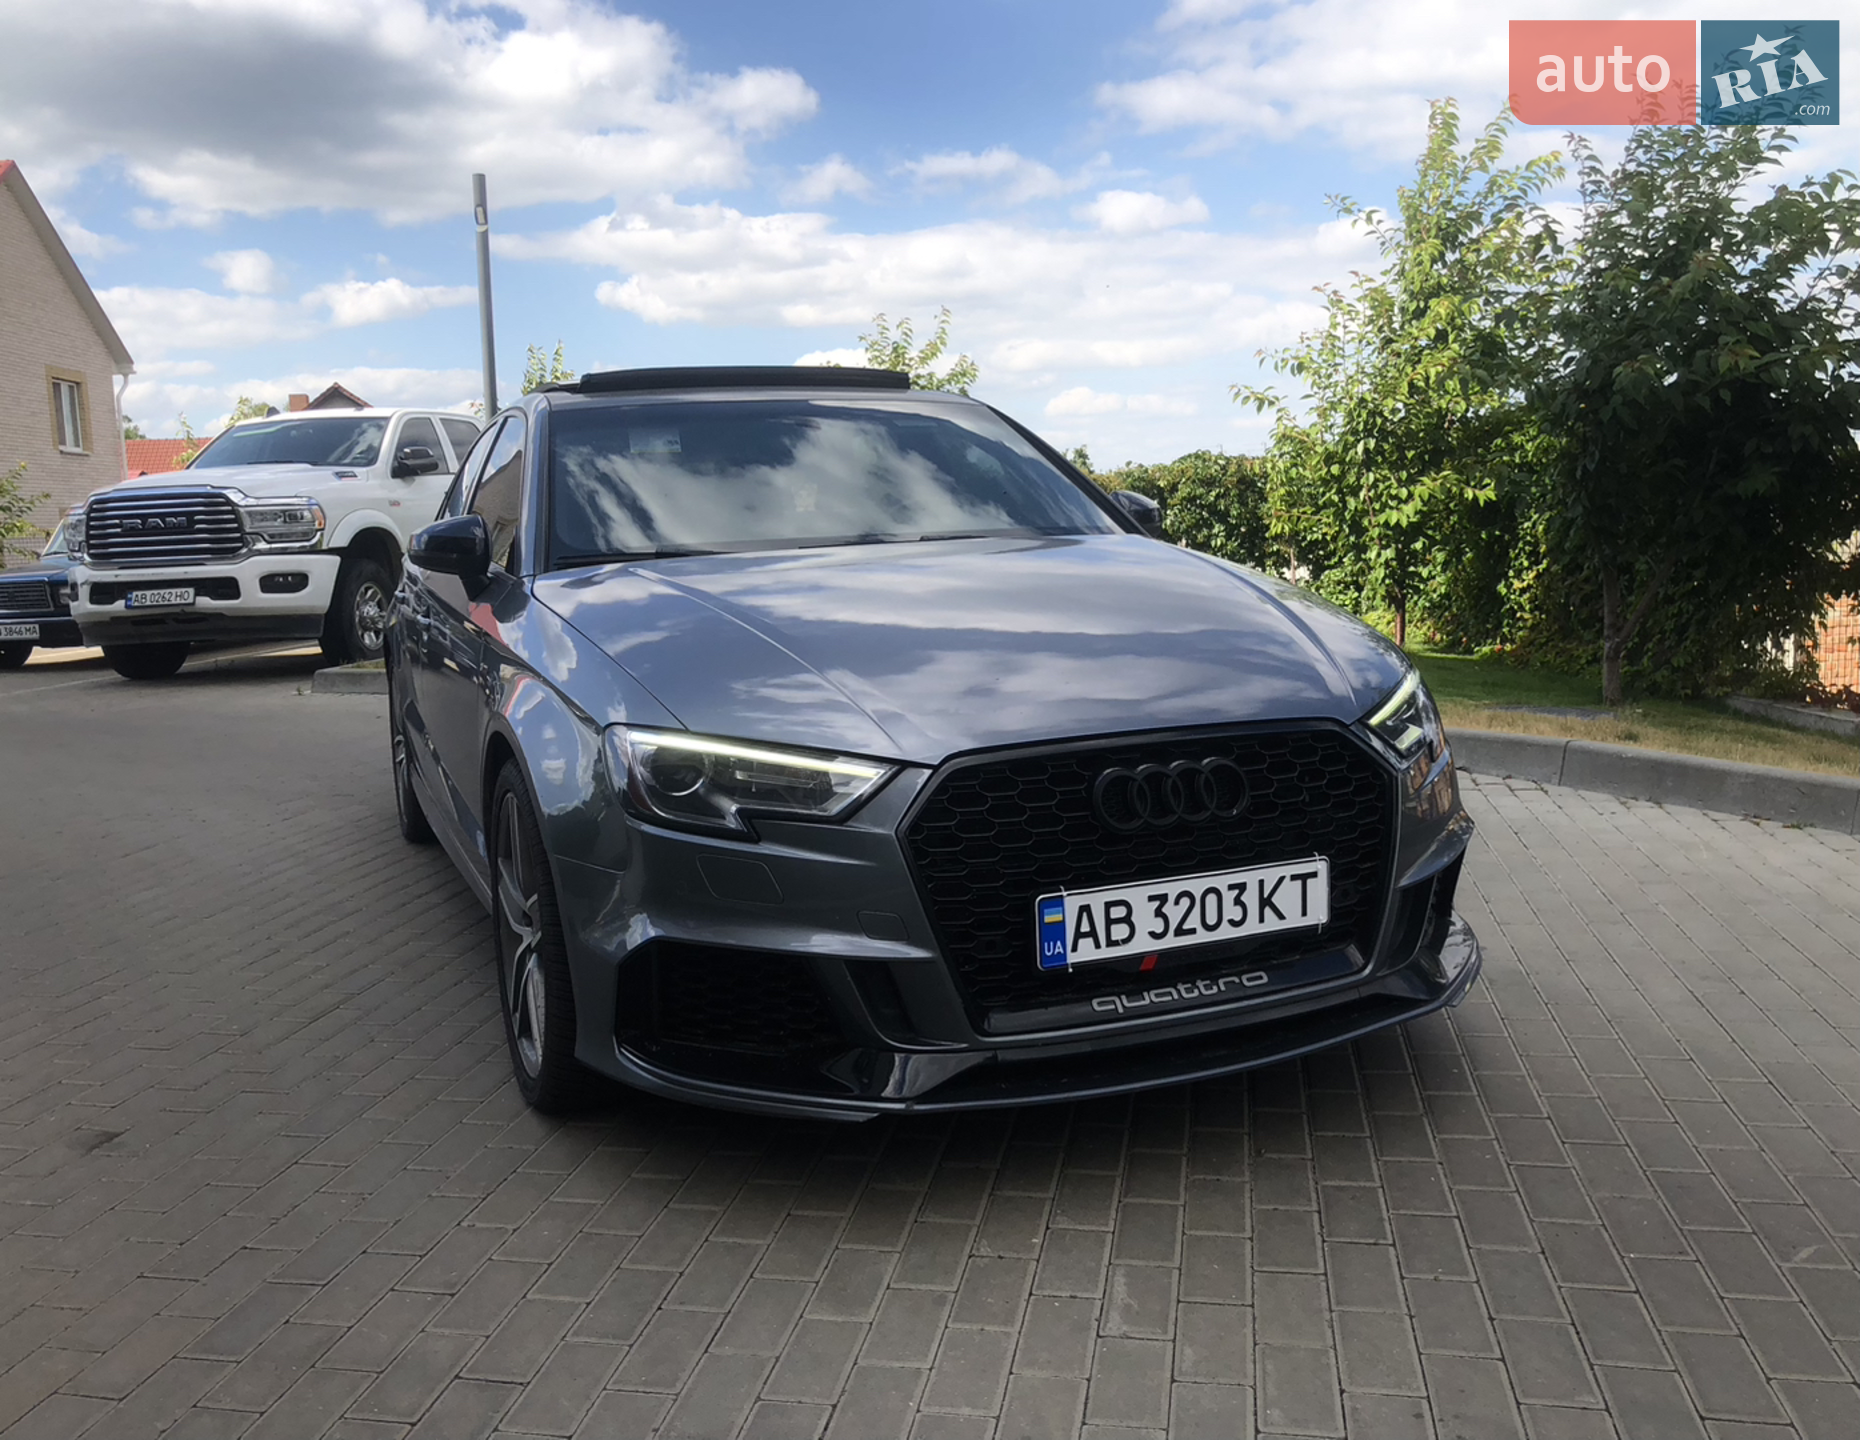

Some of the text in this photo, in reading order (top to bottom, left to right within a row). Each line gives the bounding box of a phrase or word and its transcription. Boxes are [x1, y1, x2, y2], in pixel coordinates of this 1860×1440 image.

[122, 517, 187, 529] RAM
[132, 593, 148, 605] AB
[149, 591, 173, 604] 0262
[175, 590, 190, 601] HO
[24, 625, 38, 636] MA
[1070, 870, 1319, 953] AB 3203 KT
[1044, 940, 1064, 956] UA
[1091, 970, 1269, 1014] quattro
